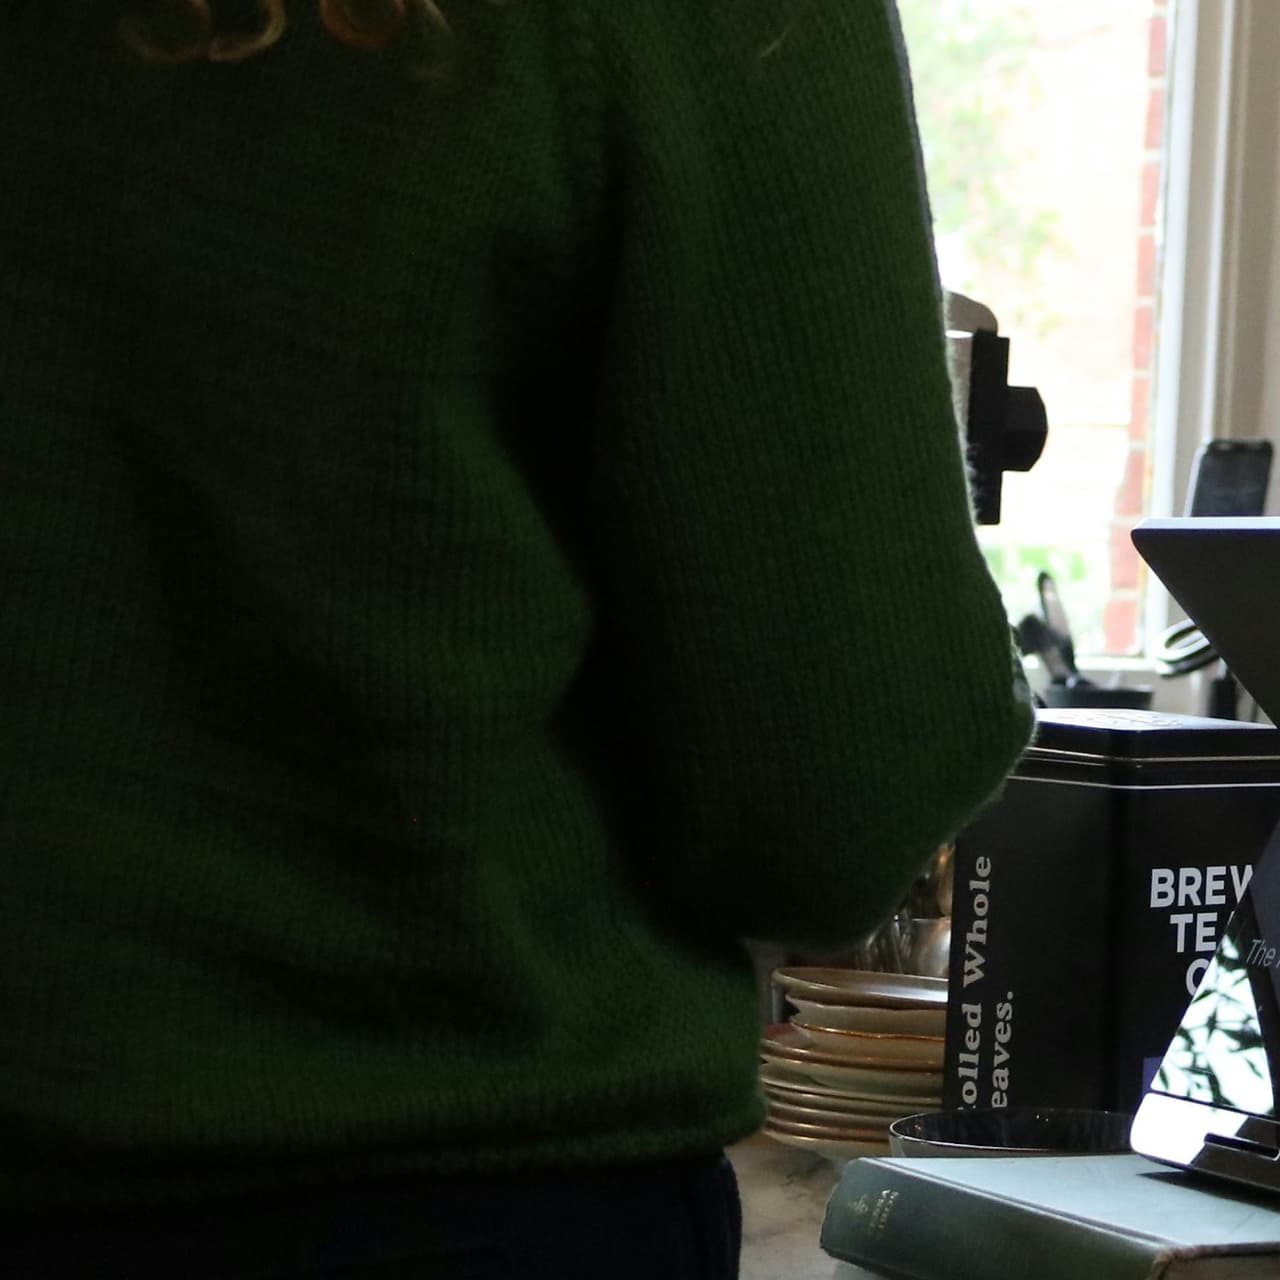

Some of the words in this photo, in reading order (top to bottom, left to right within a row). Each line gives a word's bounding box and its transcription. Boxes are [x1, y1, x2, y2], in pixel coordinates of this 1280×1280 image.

[963, 855, 992, 988] Whole
[1170, 911, 1218, 953] TE
[1246, 939, 1277, 968] The
[957, 1002, 982, 1110] olled
[991, 991, 1014, 1109] eaves.
